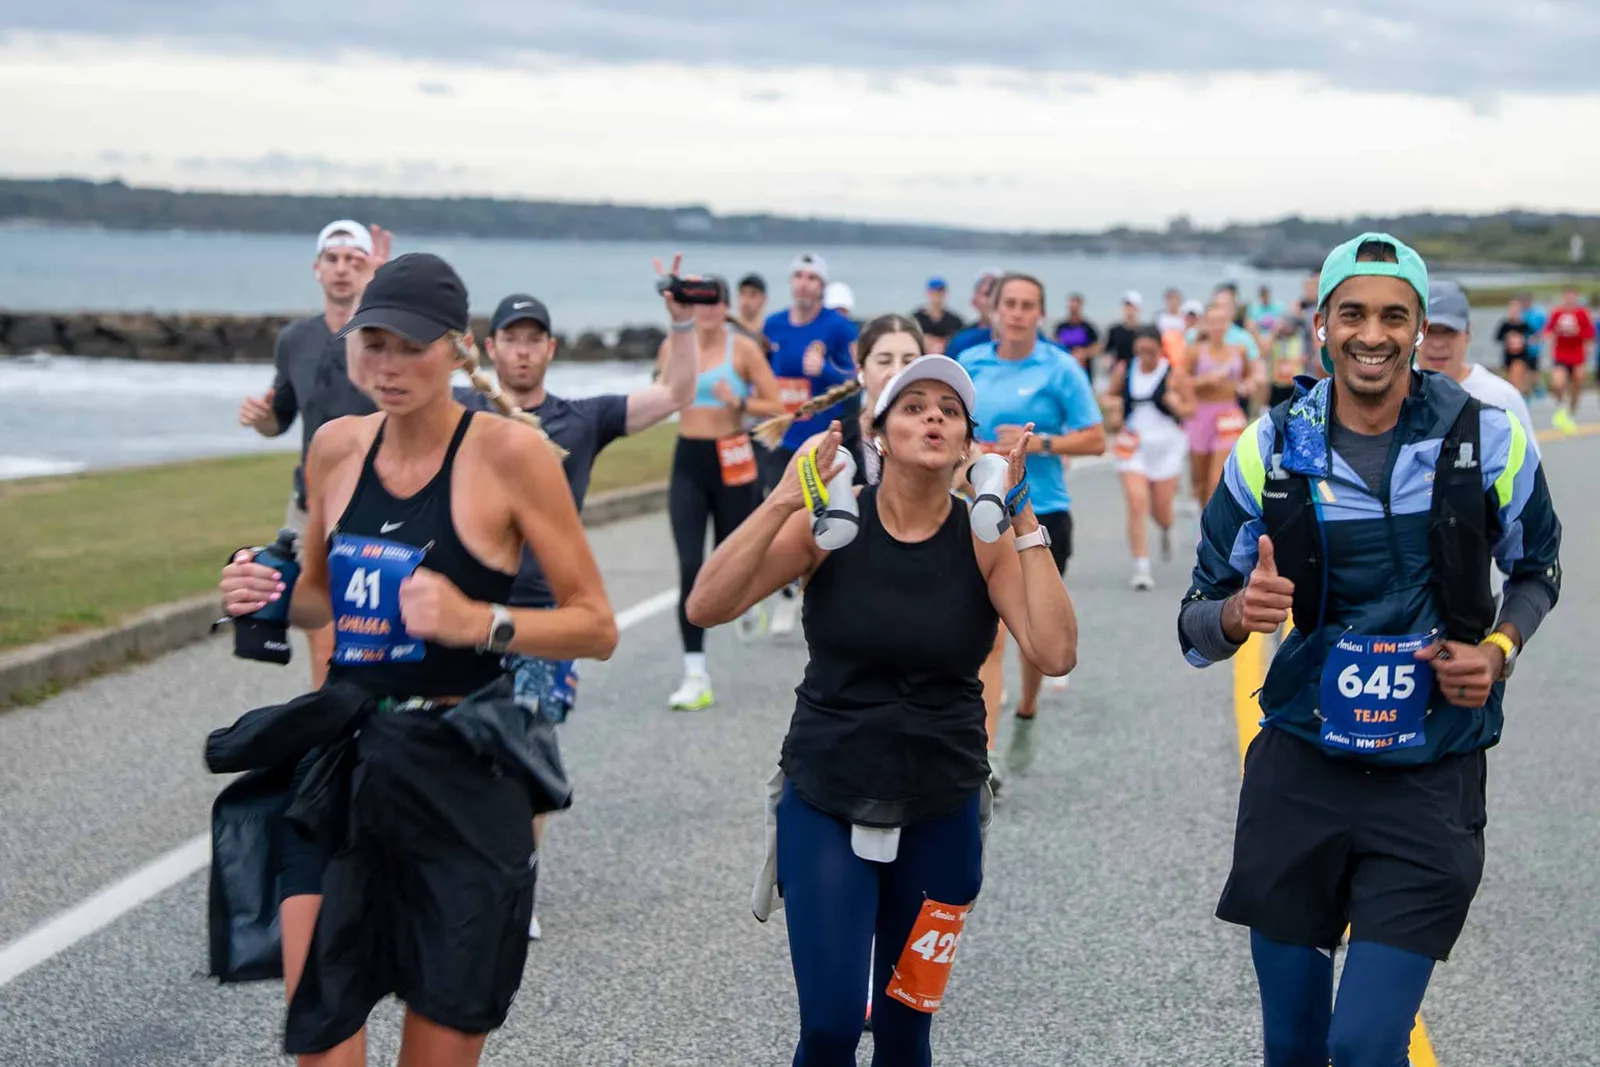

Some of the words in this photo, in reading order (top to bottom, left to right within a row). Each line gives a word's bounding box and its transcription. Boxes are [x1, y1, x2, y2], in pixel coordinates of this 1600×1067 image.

[1262, 490, 1288, 499] ALOMON
[344, 566, 381, 610] 41
[1337, 638, 1363, 653] Amica
[1373, 641, 1396, 654] NM
[1337, 663, 1416, 700] 645
[1353, 708, 1398, 723] TEJAS
[1324, 731, 1350, 745] Amica
